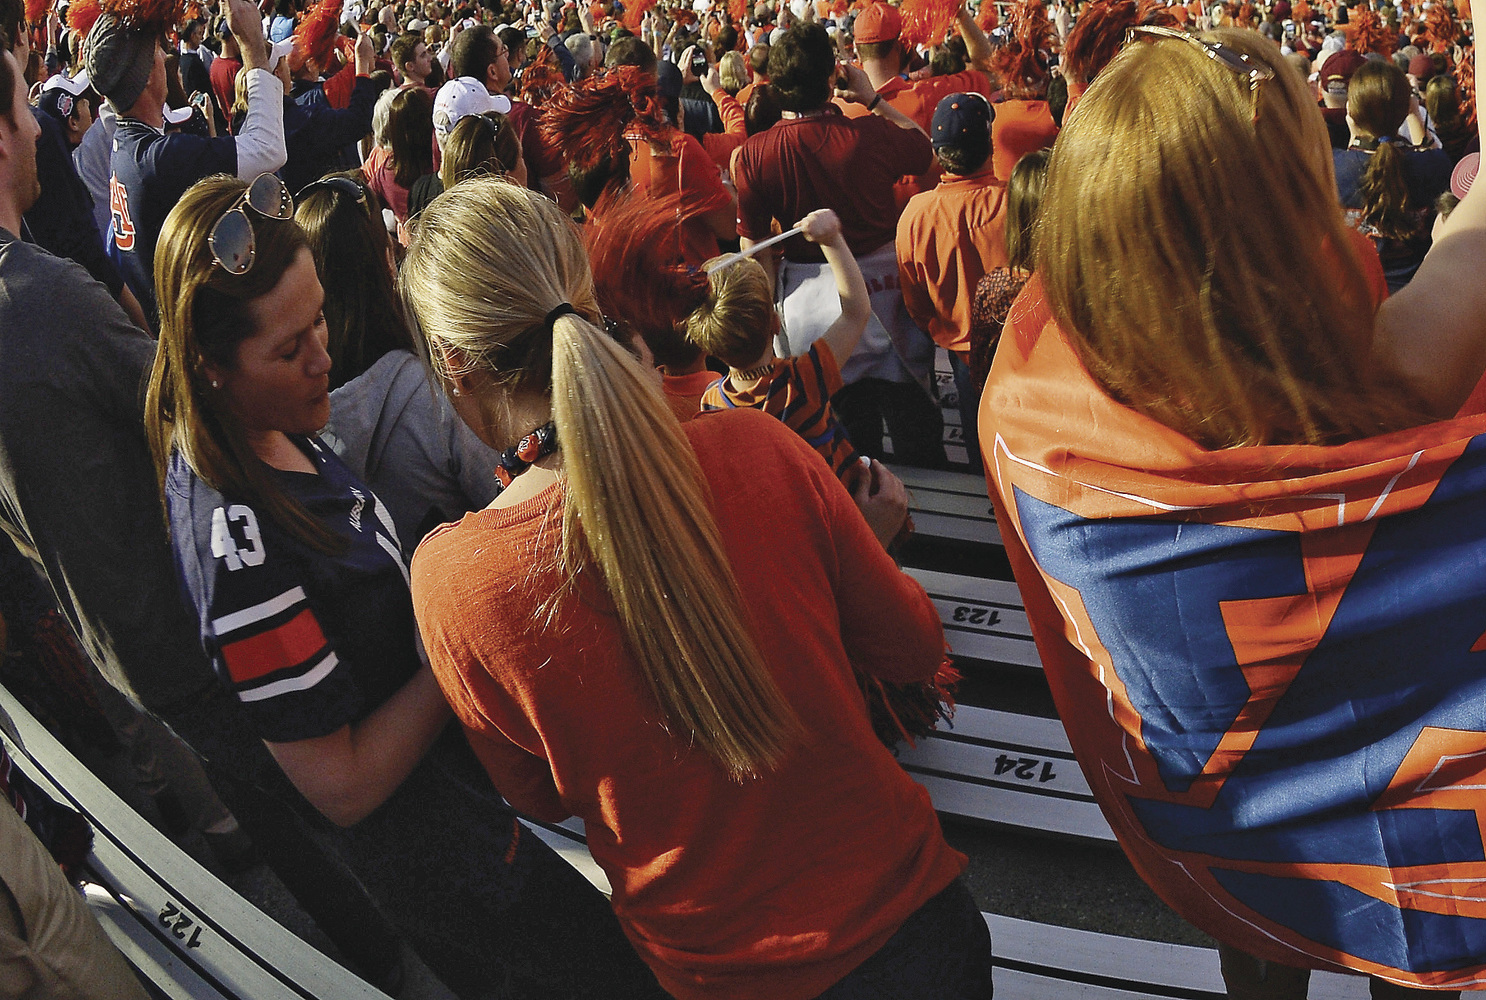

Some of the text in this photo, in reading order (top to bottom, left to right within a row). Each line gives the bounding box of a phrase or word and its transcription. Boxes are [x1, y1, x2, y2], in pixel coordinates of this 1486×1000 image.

[211, 504, 266, 572] 43
[952, 606, 1002, 627] 123
[993, 754, 1057, 783] 124
[158, 901, 203, 949] 122
